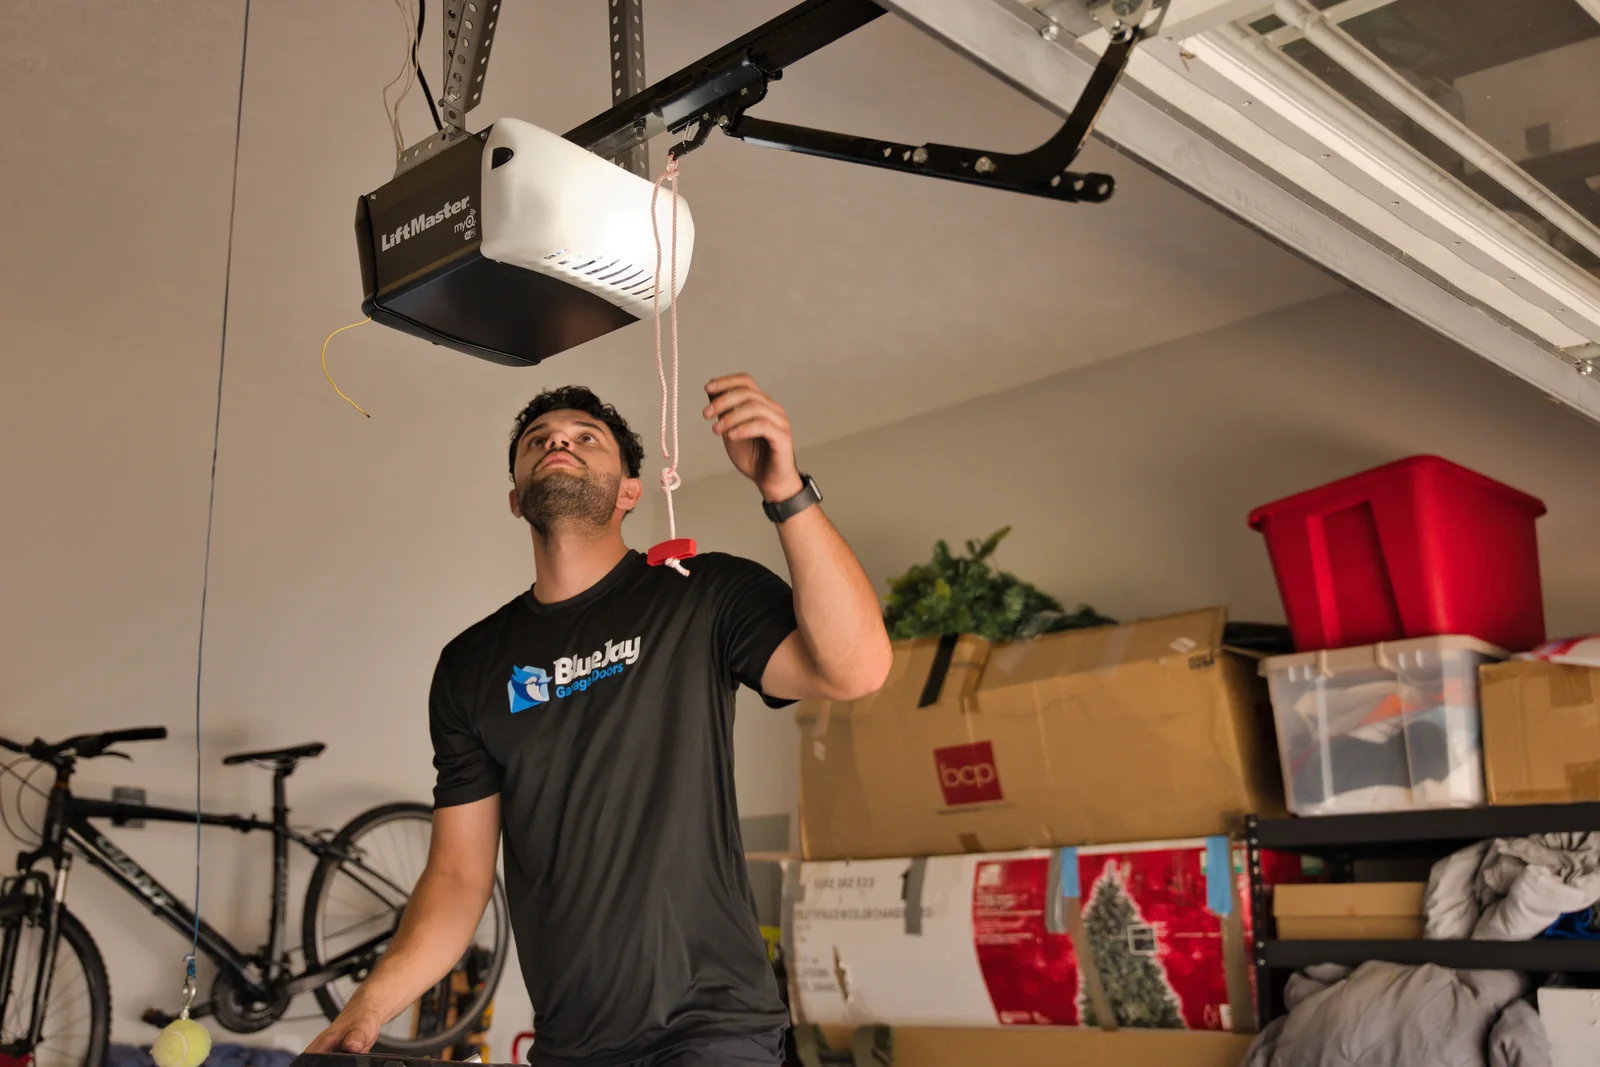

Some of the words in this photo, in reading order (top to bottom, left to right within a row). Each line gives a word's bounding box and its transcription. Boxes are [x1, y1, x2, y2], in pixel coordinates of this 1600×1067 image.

[381, 196, 470, 252] LiftMaster
[454, 214, 476, 234] myQ
[940, 762, 994, 789] bcp
